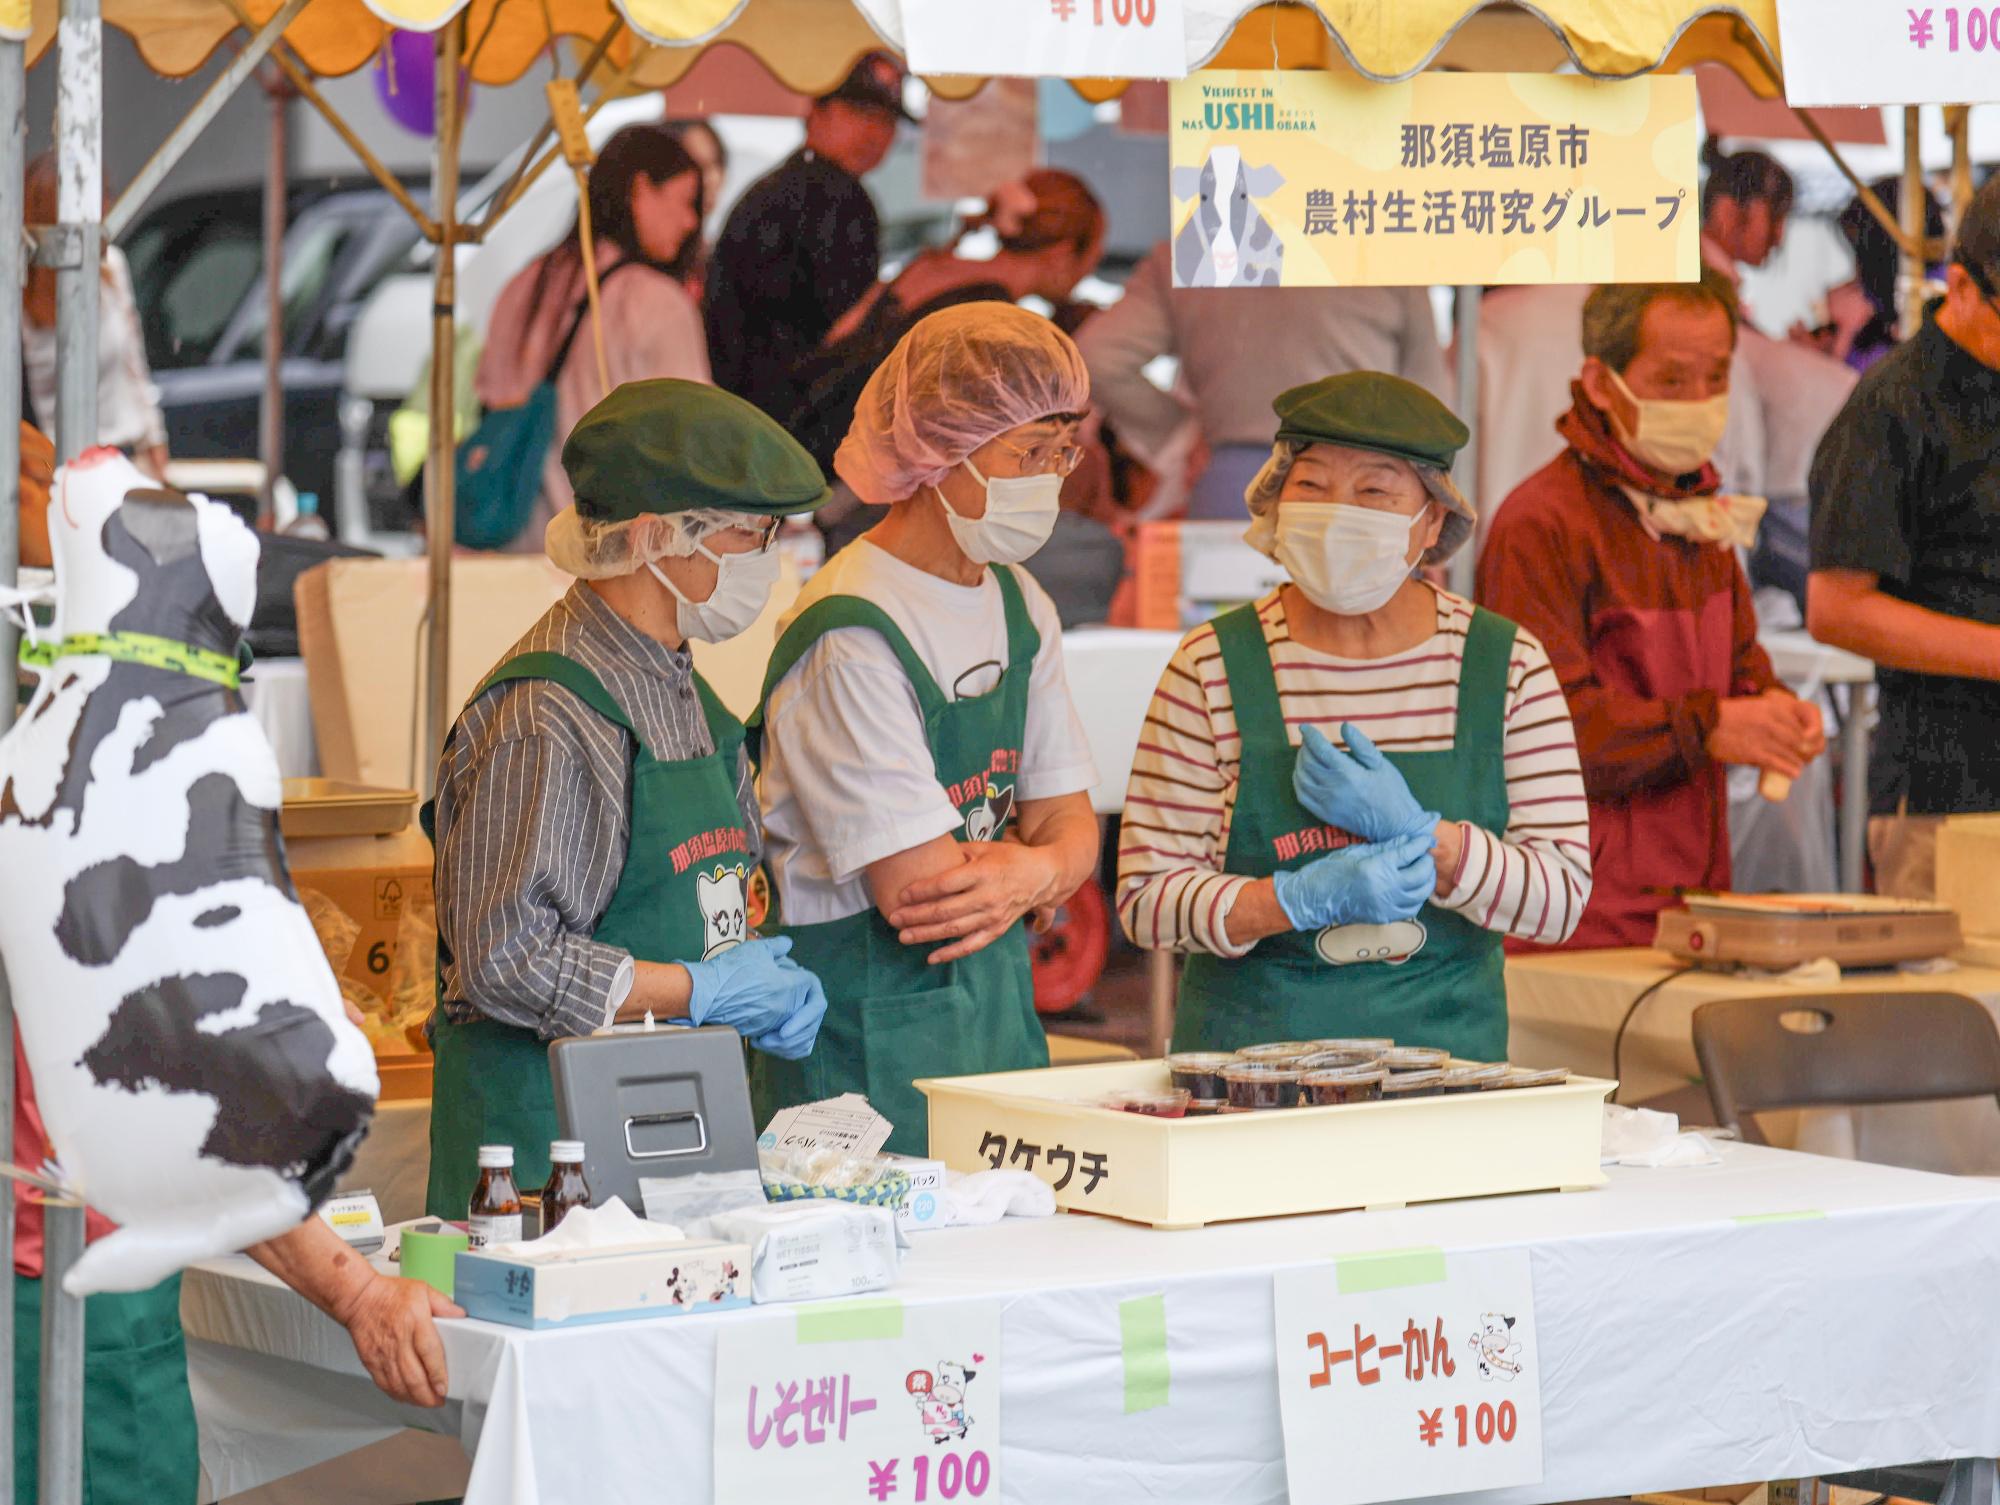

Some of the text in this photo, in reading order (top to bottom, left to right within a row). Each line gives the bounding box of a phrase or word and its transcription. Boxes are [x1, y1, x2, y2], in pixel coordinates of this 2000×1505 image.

[1400, 123, 1590, 169] 那須塩原市
[1302, 187, 1686, 237] 農村生活研究グループ
[978, 1130, 1109, 1196] タケウチ
[1307, 1316, 1456, 1389] コーヒーかん
[747, 1373, 878, 1450] しそゼリー
[1417, 1399, 1518, 1448] ¥100
[867, 1450, 991, 1503] ¥100
